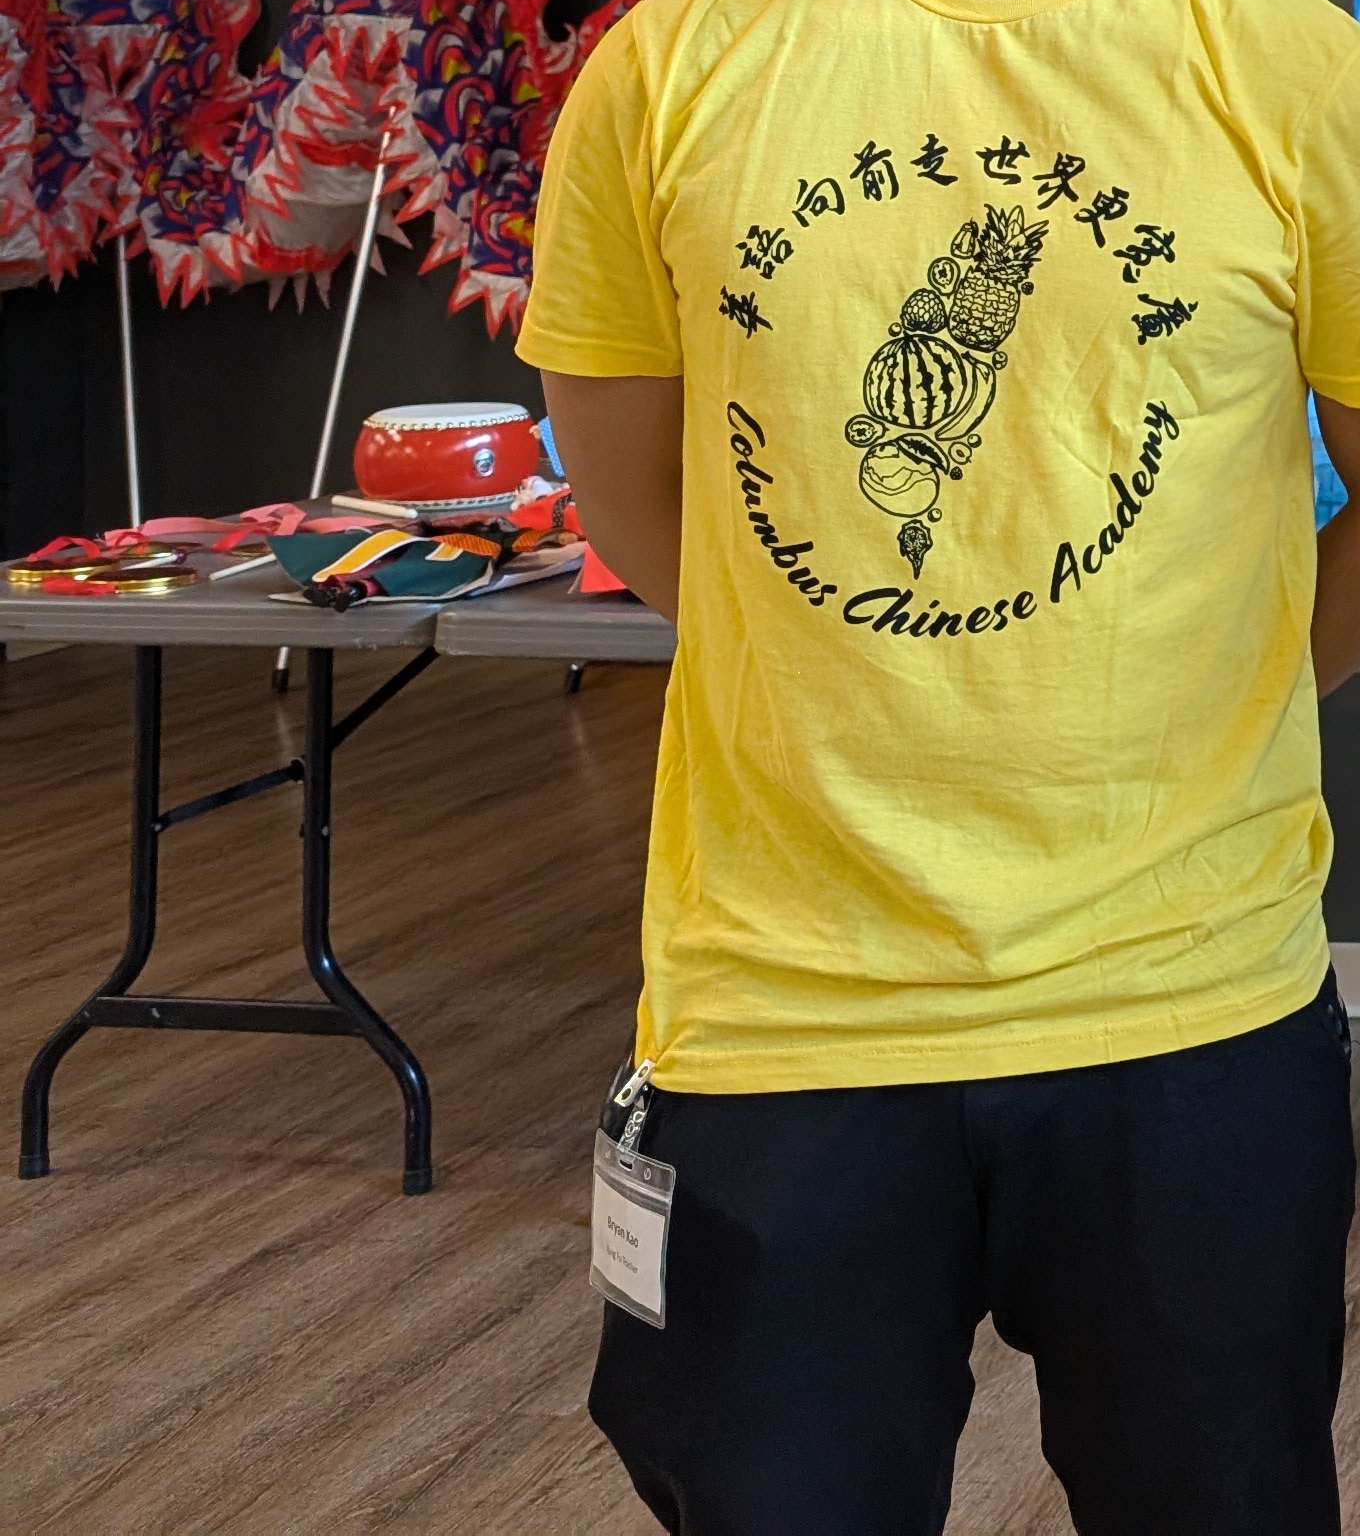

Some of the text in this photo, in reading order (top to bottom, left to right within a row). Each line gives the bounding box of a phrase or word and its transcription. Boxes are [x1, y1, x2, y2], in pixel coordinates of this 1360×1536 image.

[727, 400, 1181, 639] Columbus Chinese Academy
